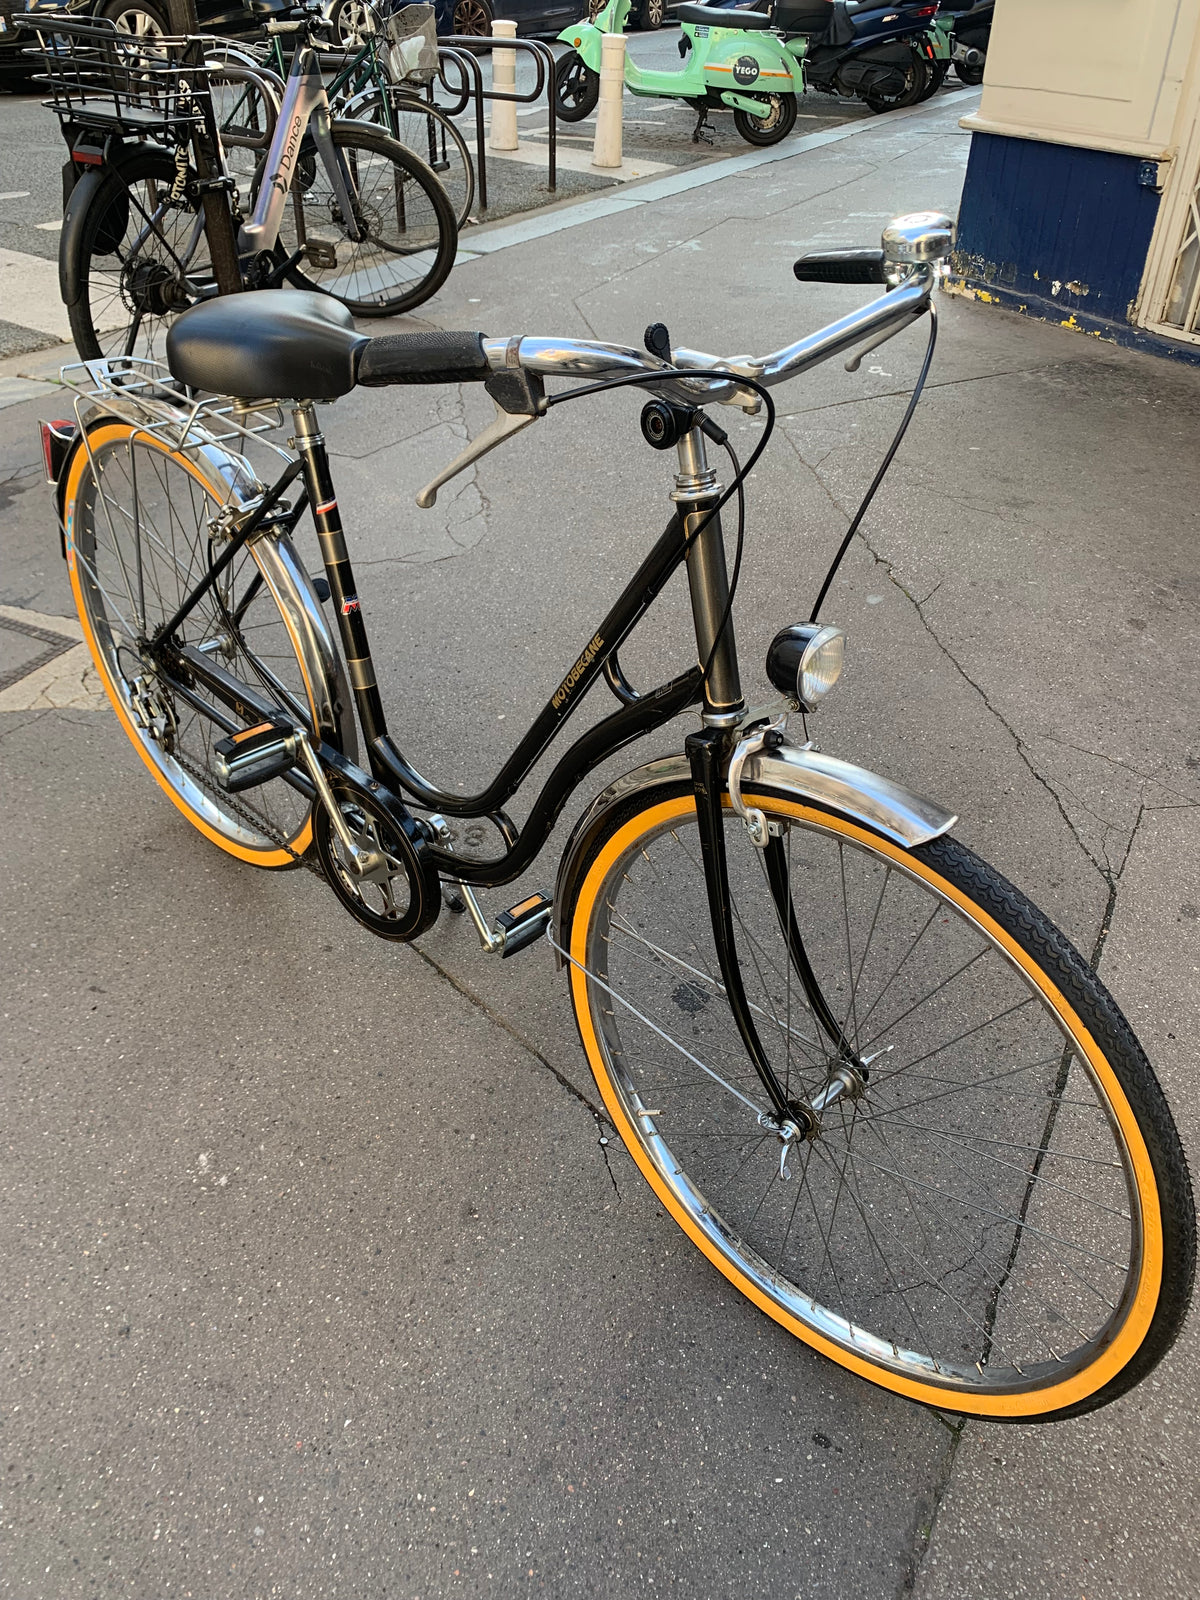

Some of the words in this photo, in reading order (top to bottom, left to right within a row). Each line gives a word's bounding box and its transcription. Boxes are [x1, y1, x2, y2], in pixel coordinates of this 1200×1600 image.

[735, 66, 758, 75] YEGO
[280, 115, 302, 170] Dance
[551, 632, 605, 709] MOTOBECANE
